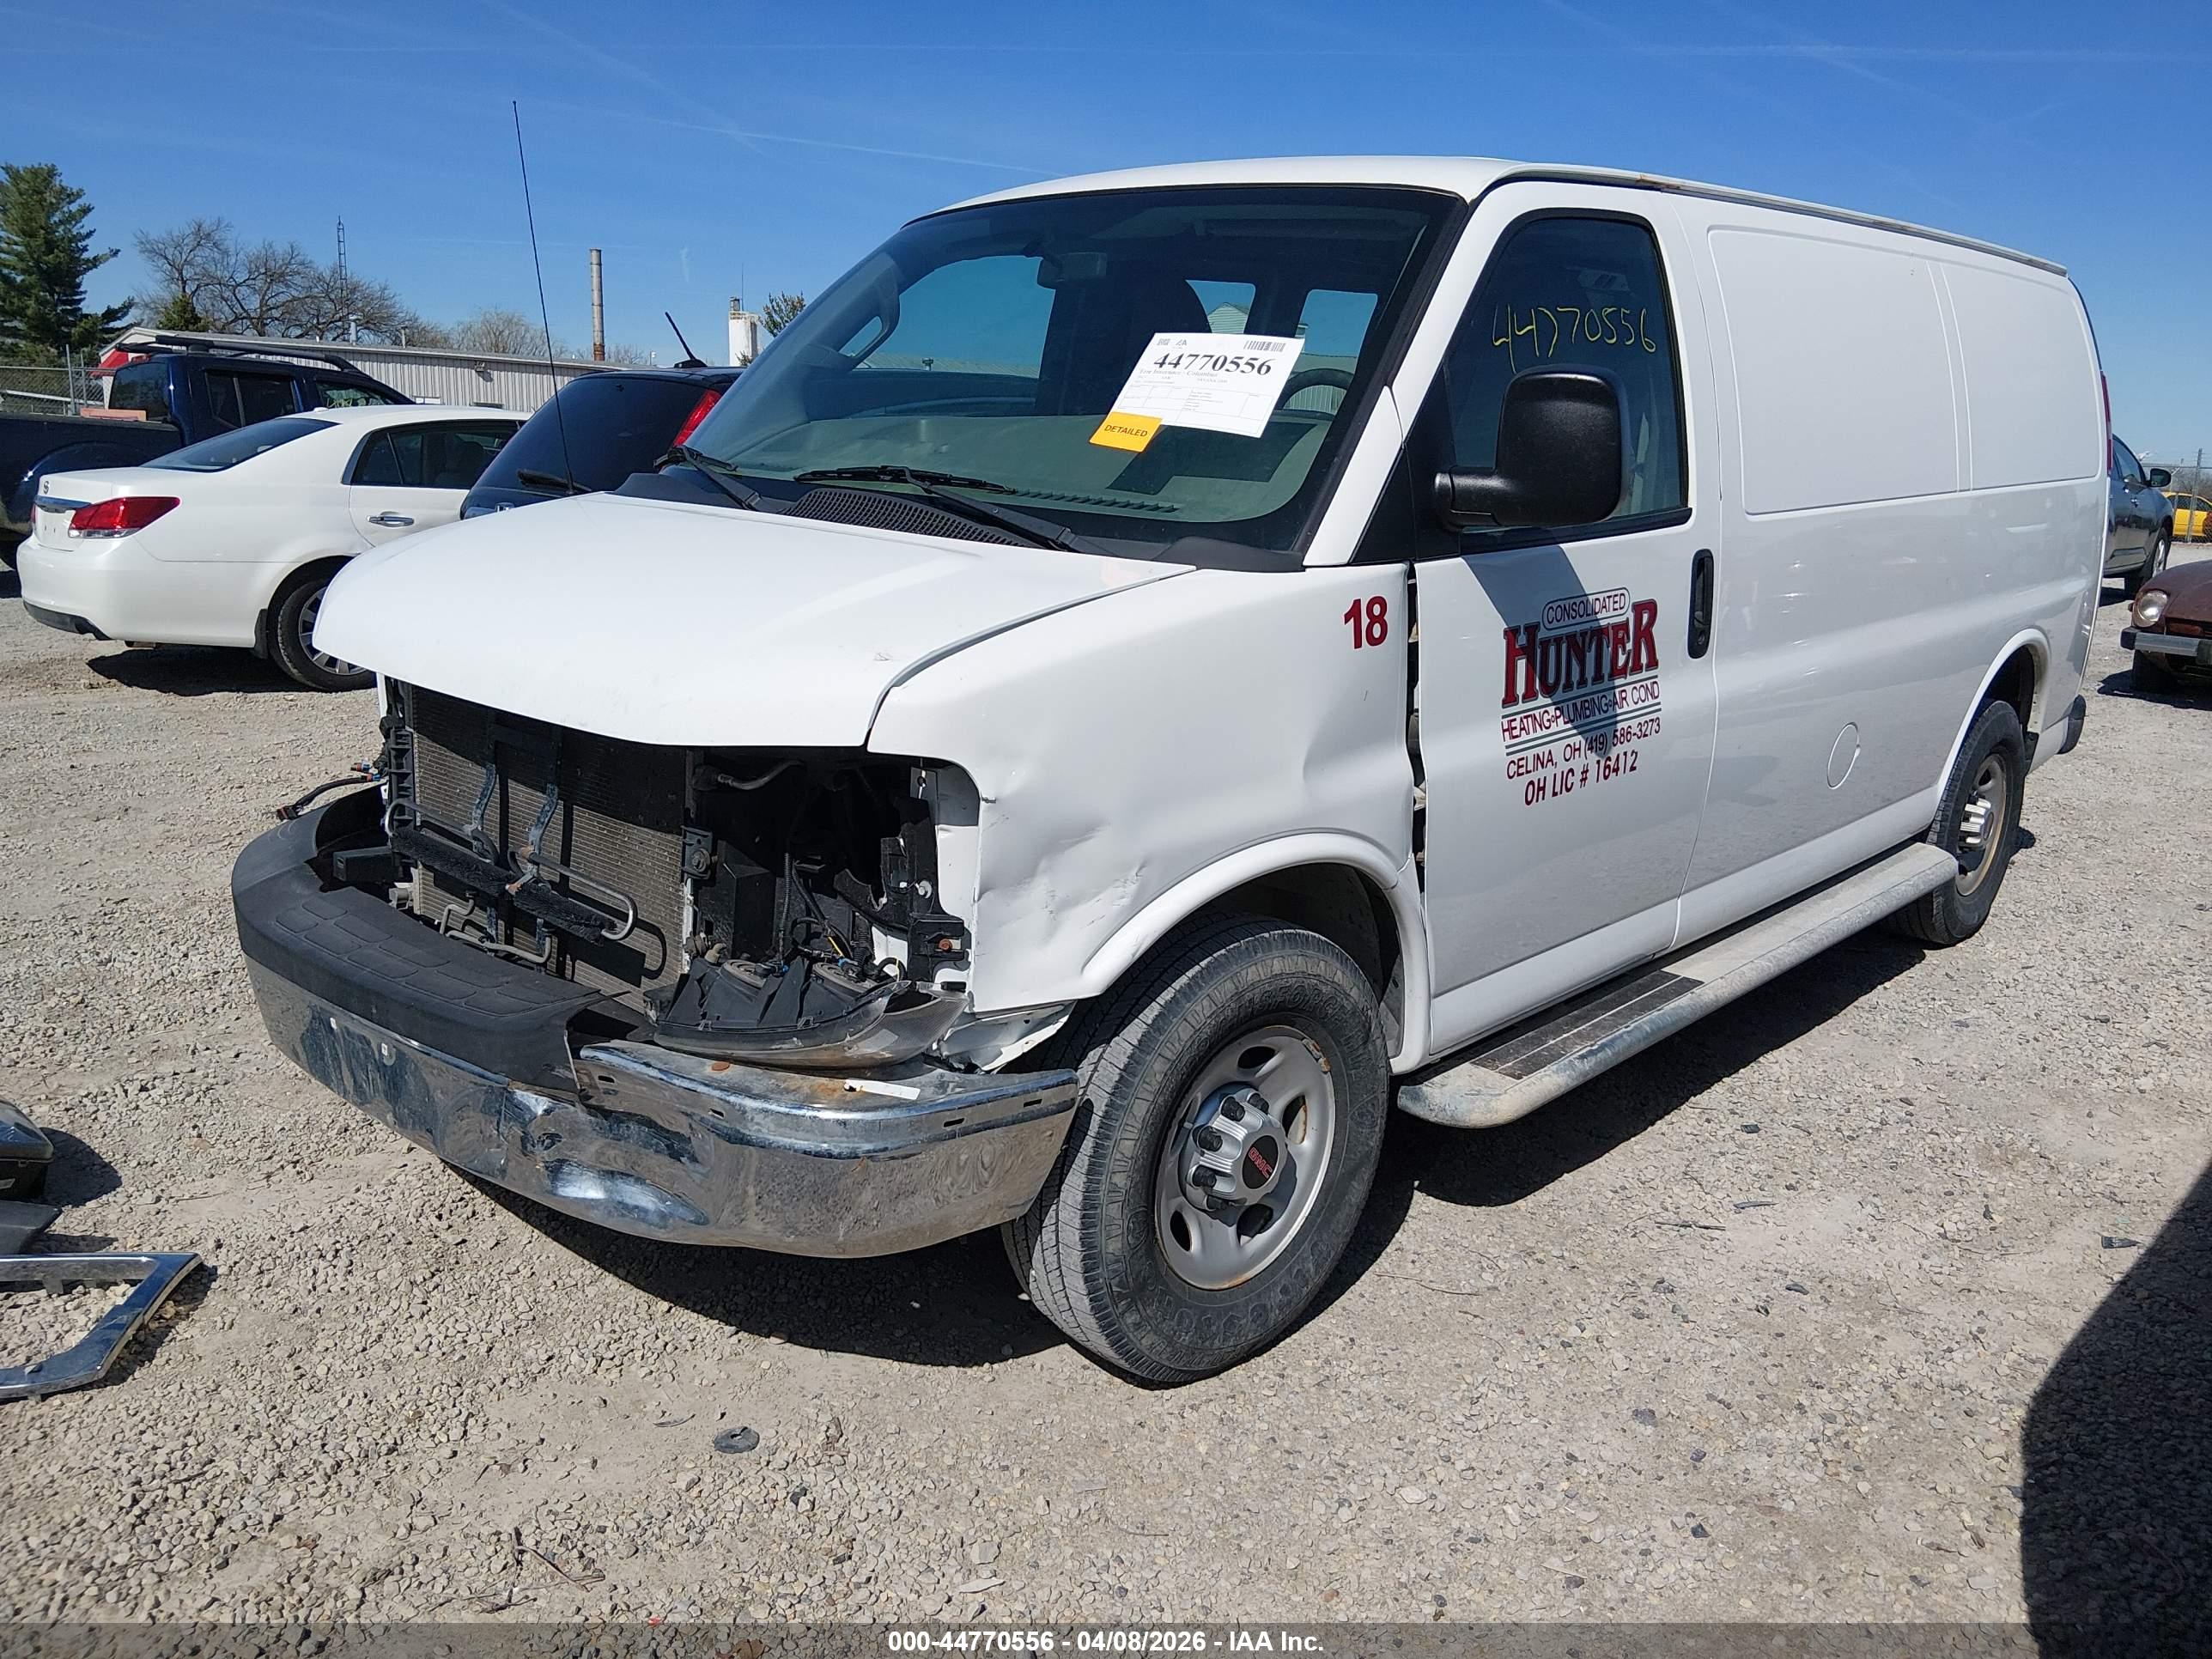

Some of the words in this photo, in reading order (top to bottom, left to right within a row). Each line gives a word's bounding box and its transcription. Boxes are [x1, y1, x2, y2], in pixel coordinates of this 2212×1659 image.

[1153, 353, 1279, 376] 44770556
[1104, 424, 1149, 438] DETAILED
[1344, 595, 1389, 650] 18
[1546, 592, 1626, 625] CONSOLIDATED
[1501, 599, 1660, 708] HUNTER
[1631, 680, 1660, 706] COND
[1506, 749, 1558, 780] CELINA,
[1563, 741, 1581, 763] OH
[1583, 732, 1608, 760] (419)
[1612, 717, 1662, 747] 586-3273
[1524, 775, 1547, 806] OH
[1552, 768, 1575, 798] LIC
[1579, 764, 1589, 788] #
[1595, 749, 1638, 784] 16412
[1248, 1147, 1273, 1180] GMC
